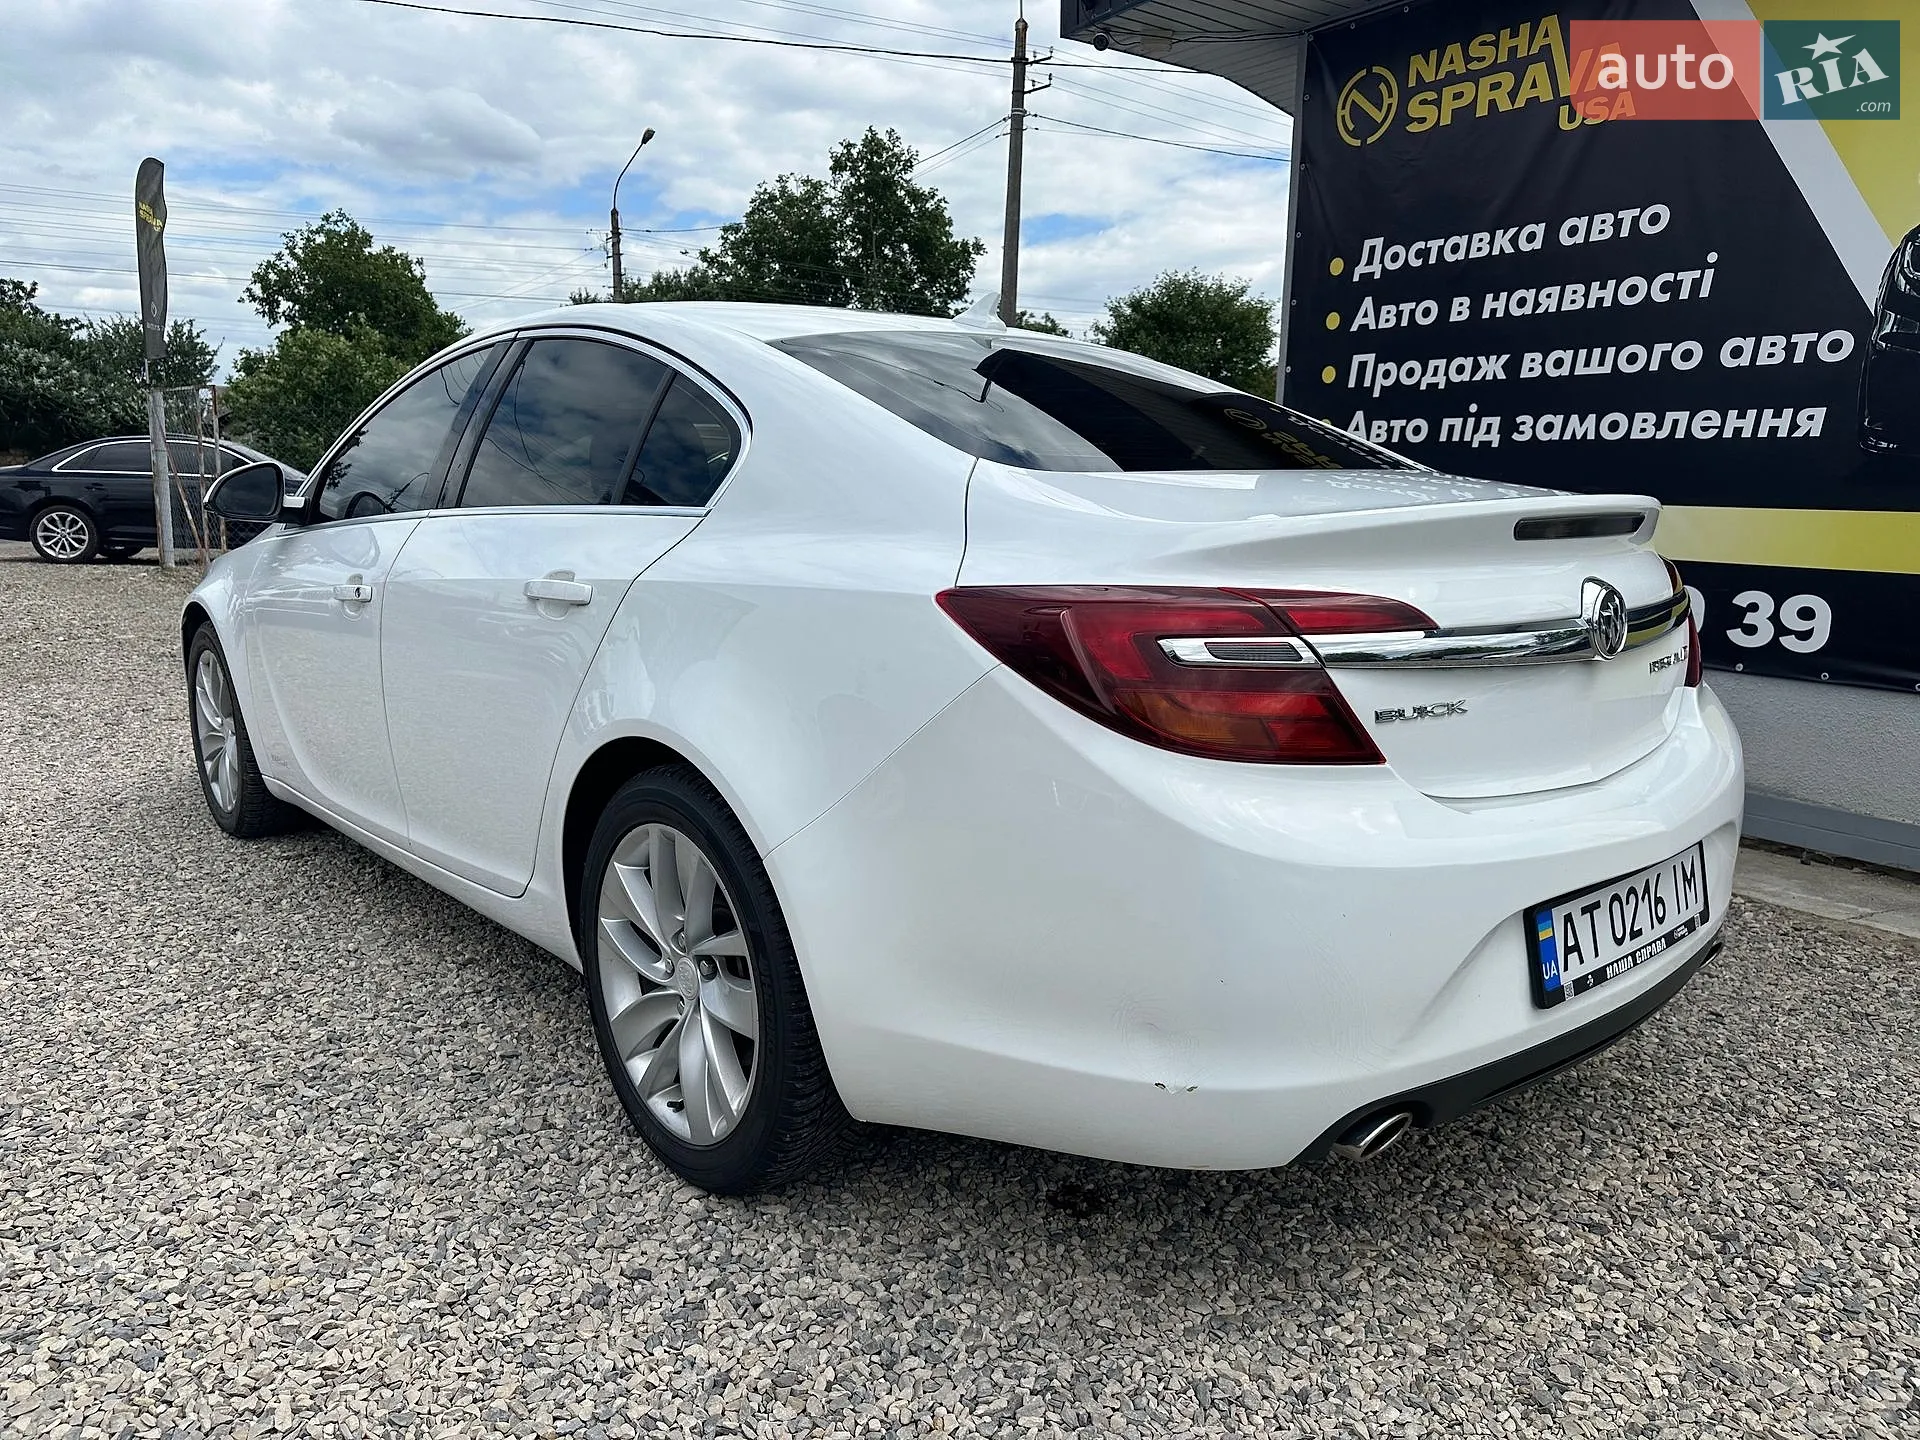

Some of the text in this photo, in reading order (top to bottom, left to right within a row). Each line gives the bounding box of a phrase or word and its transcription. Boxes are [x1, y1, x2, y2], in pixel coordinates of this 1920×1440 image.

[1407, 14, 1559, 88] NASHA
[1558, 91, 1636, 131] USA
[1353, 203, 1670, 282] Доставка авто
[1350, 252, 1719, 333] Авто в наявності
[1347, 329, 1854, 397] Продаж вашого авто
[1346, 403, 1827, 447] Авто під замовлення
[1726, 590, 1832, 654] 39
[1374, 699, 1468, 724] BUICK
[1563, 855, 1699, 972] AT 0216 IM
[1542, 959, 1558, 980] UA
[1606, 937, 1667, 979] НАША СПРАВА
